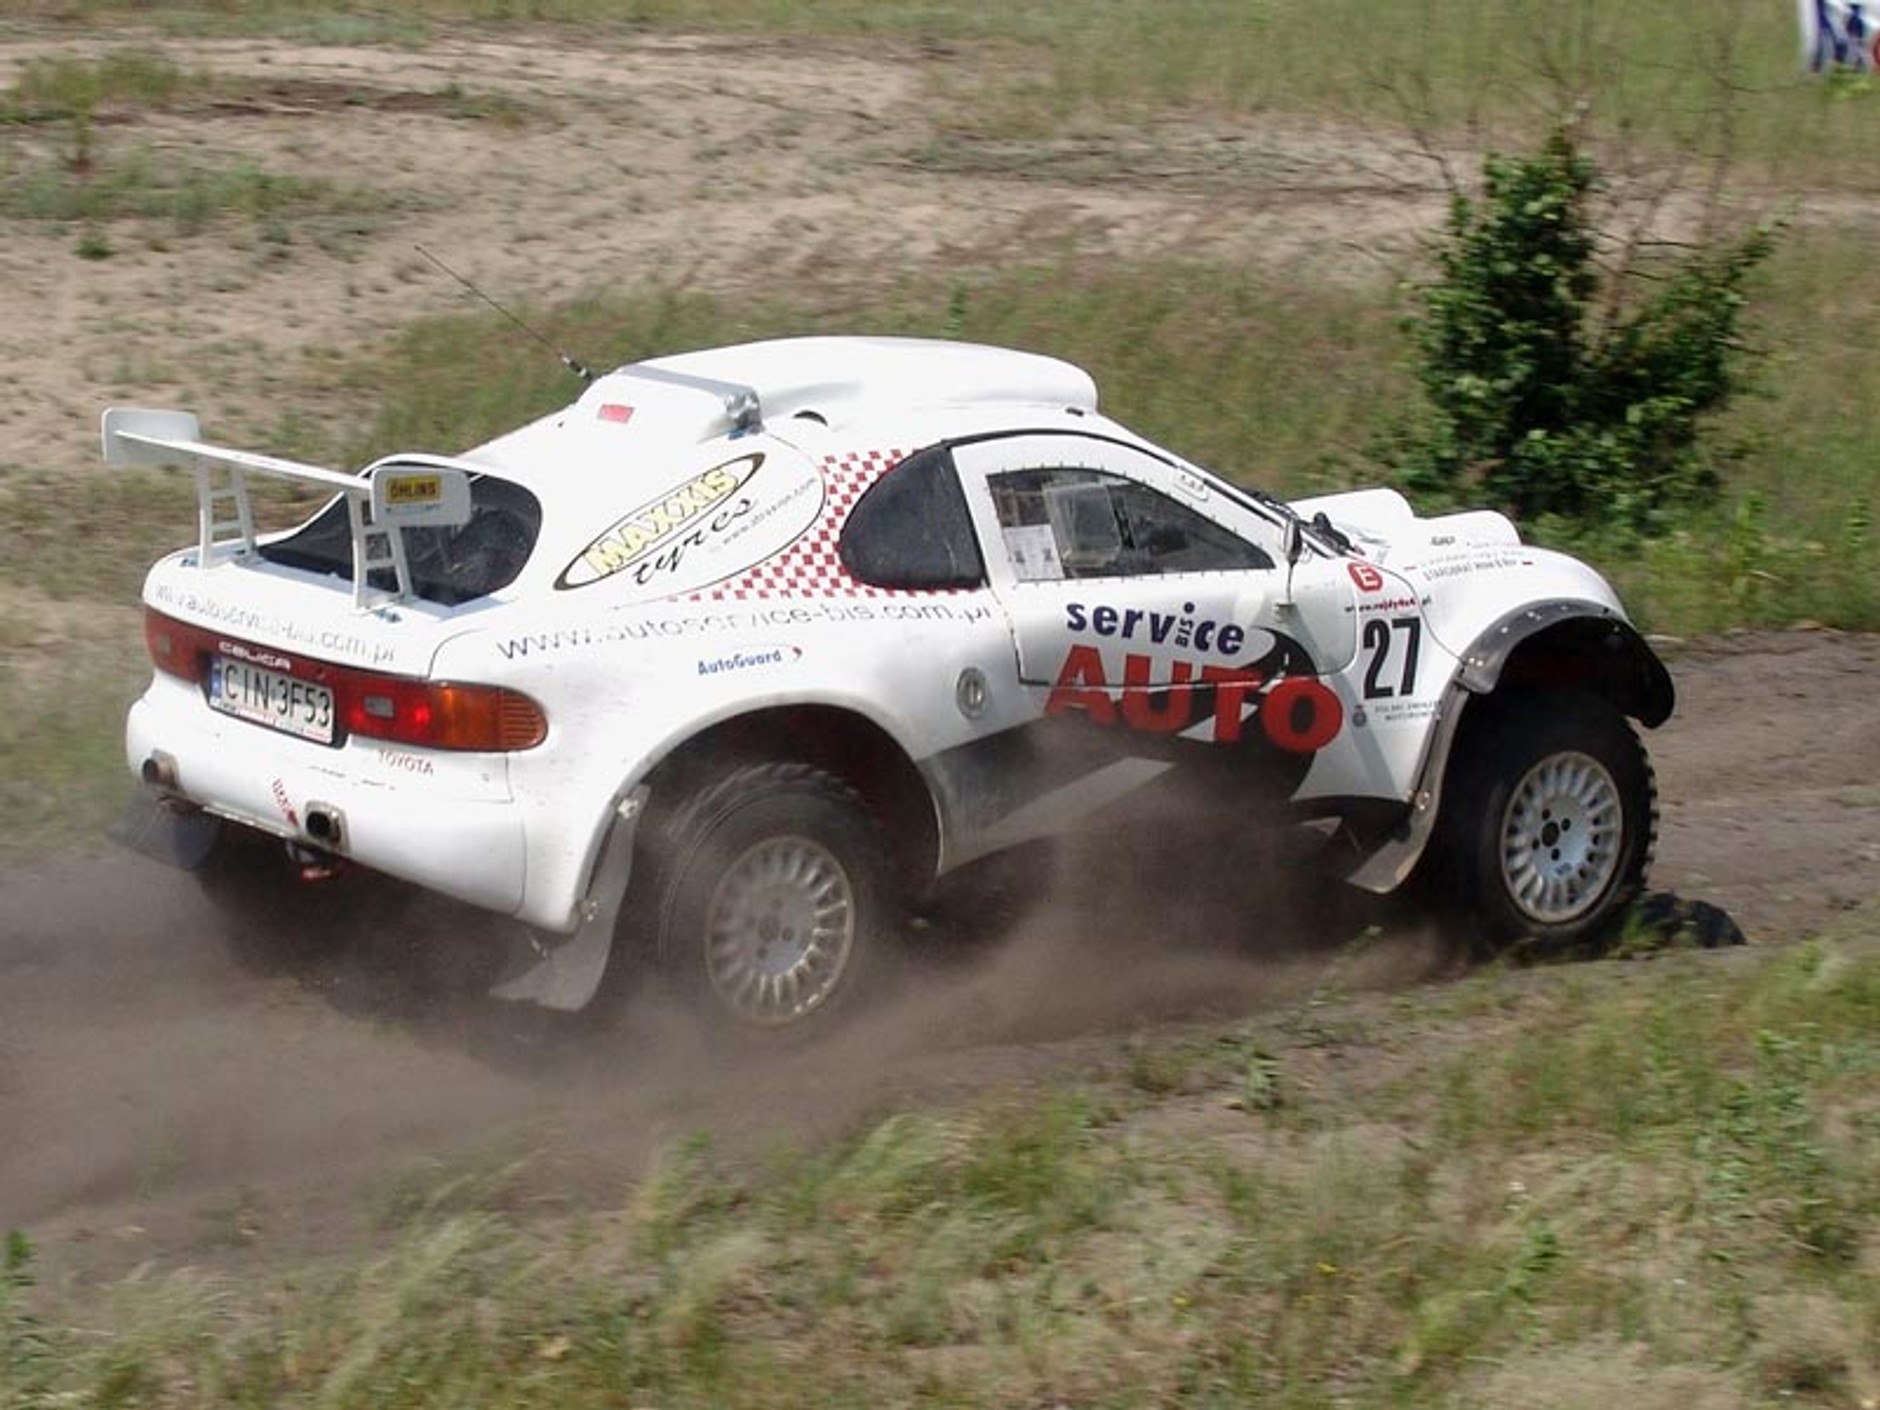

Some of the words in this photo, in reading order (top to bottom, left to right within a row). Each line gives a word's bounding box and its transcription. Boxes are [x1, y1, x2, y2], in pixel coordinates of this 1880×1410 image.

[583, 467, 740, 575] MAXXIS
[632, 497, 757, 586] tyres
[218, 640, 292, 672] CELICA
[1066, 601, 1246, 656] service
[1363, 616, 1421, 700] 27
[697, 647, 783, 676] AutoGuard
[225, 663, 270, 711] CIN
[277, 678, 331, 728] 3F53
[1043, 643, 1344, 753] AUTO
[378, 748, 435, 777] TOYOTA
